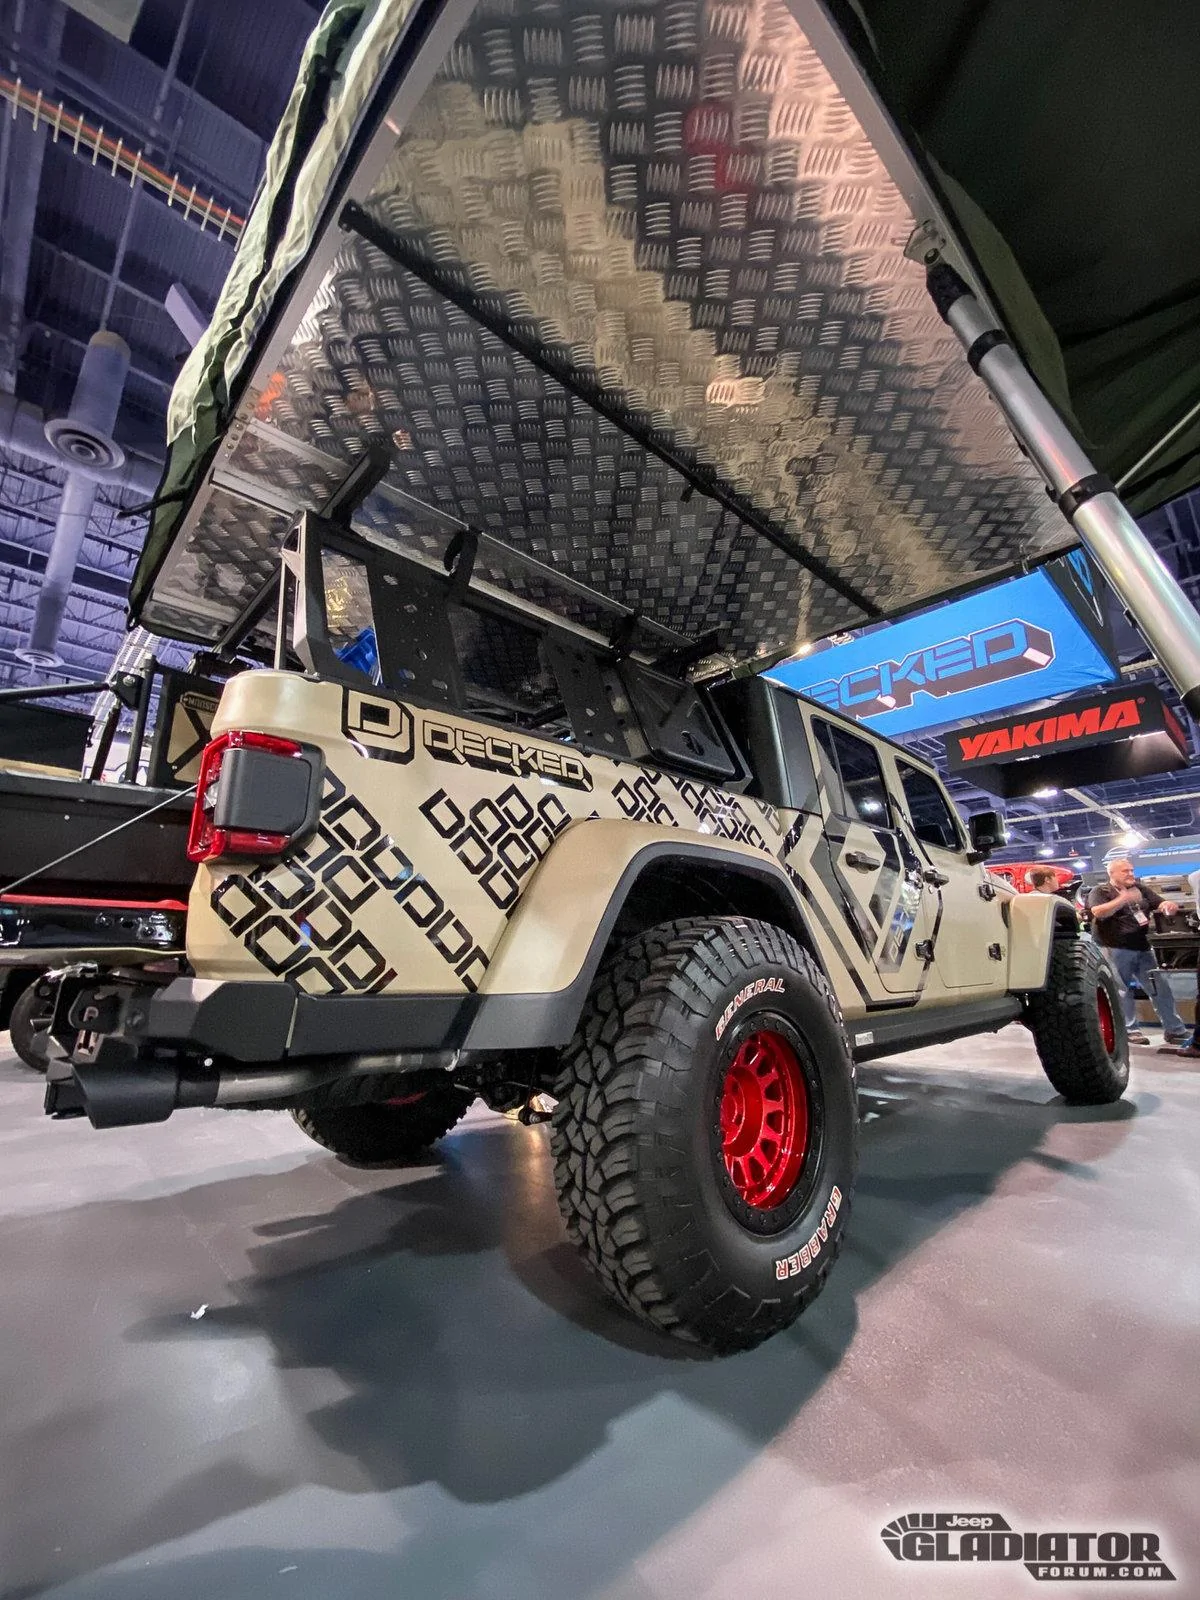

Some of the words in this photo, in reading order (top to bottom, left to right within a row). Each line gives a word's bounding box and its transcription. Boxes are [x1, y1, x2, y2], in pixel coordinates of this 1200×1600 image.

[800, 618, 1056, 720] ECKED
[422, 719, 594, 792] DECKED
[959, 699, 1141, 761] YAKIMA
[715, 977, 786, 1041] GENERAL
[776, 1185, 842, 1280] GRABBER
